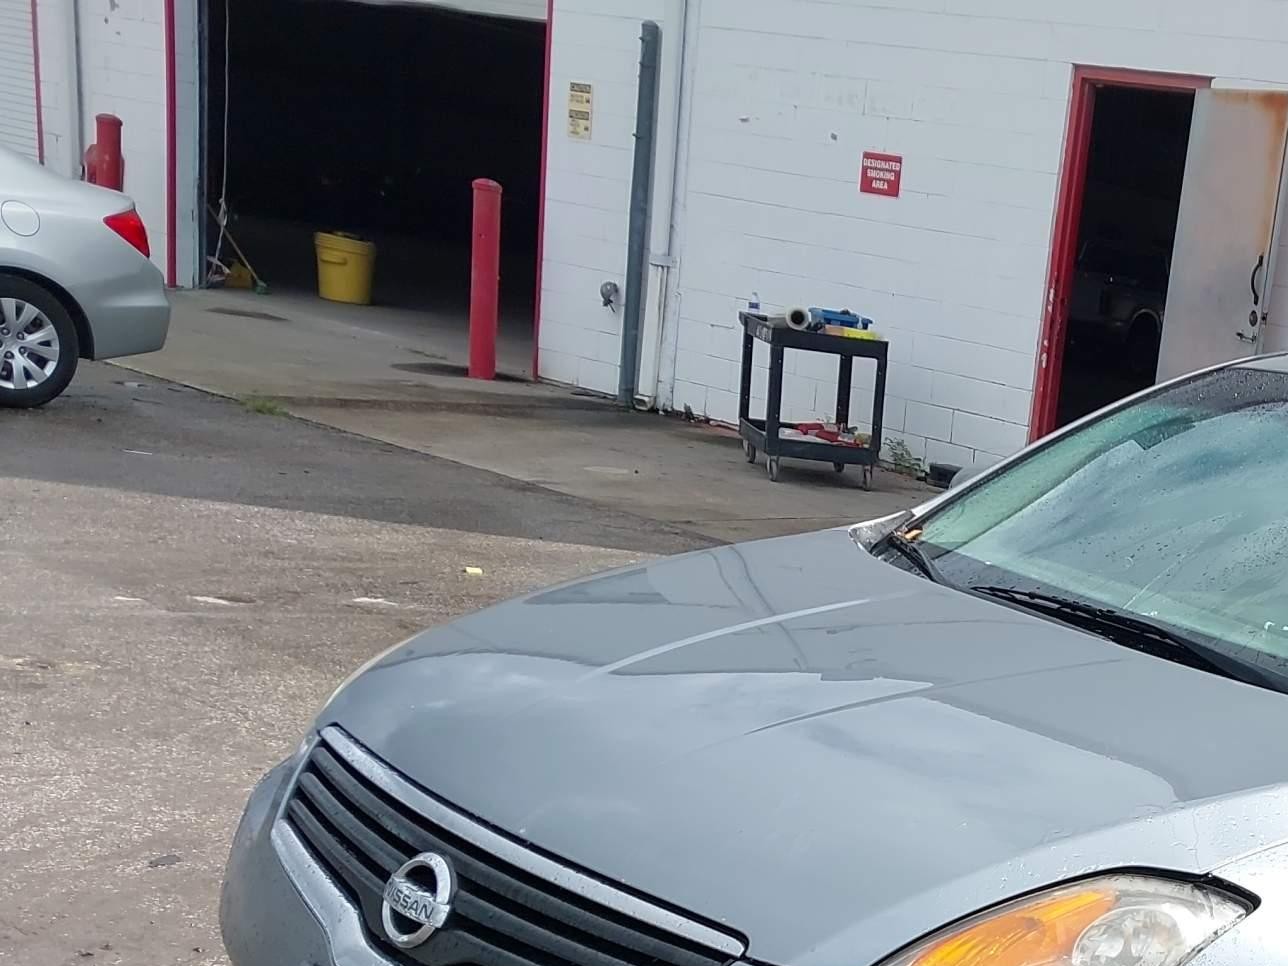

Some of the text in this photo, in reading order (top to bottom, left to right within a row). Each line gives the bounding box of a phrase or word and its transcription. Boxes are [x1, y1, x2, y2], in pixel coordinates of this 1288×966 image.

[864, 158, 900, 170] DESIGNATED
[867, 169, 894, 180] SMOKING
[871, 179, 888, 190] AREA
[385, 884, 433, 919] NISSAN
